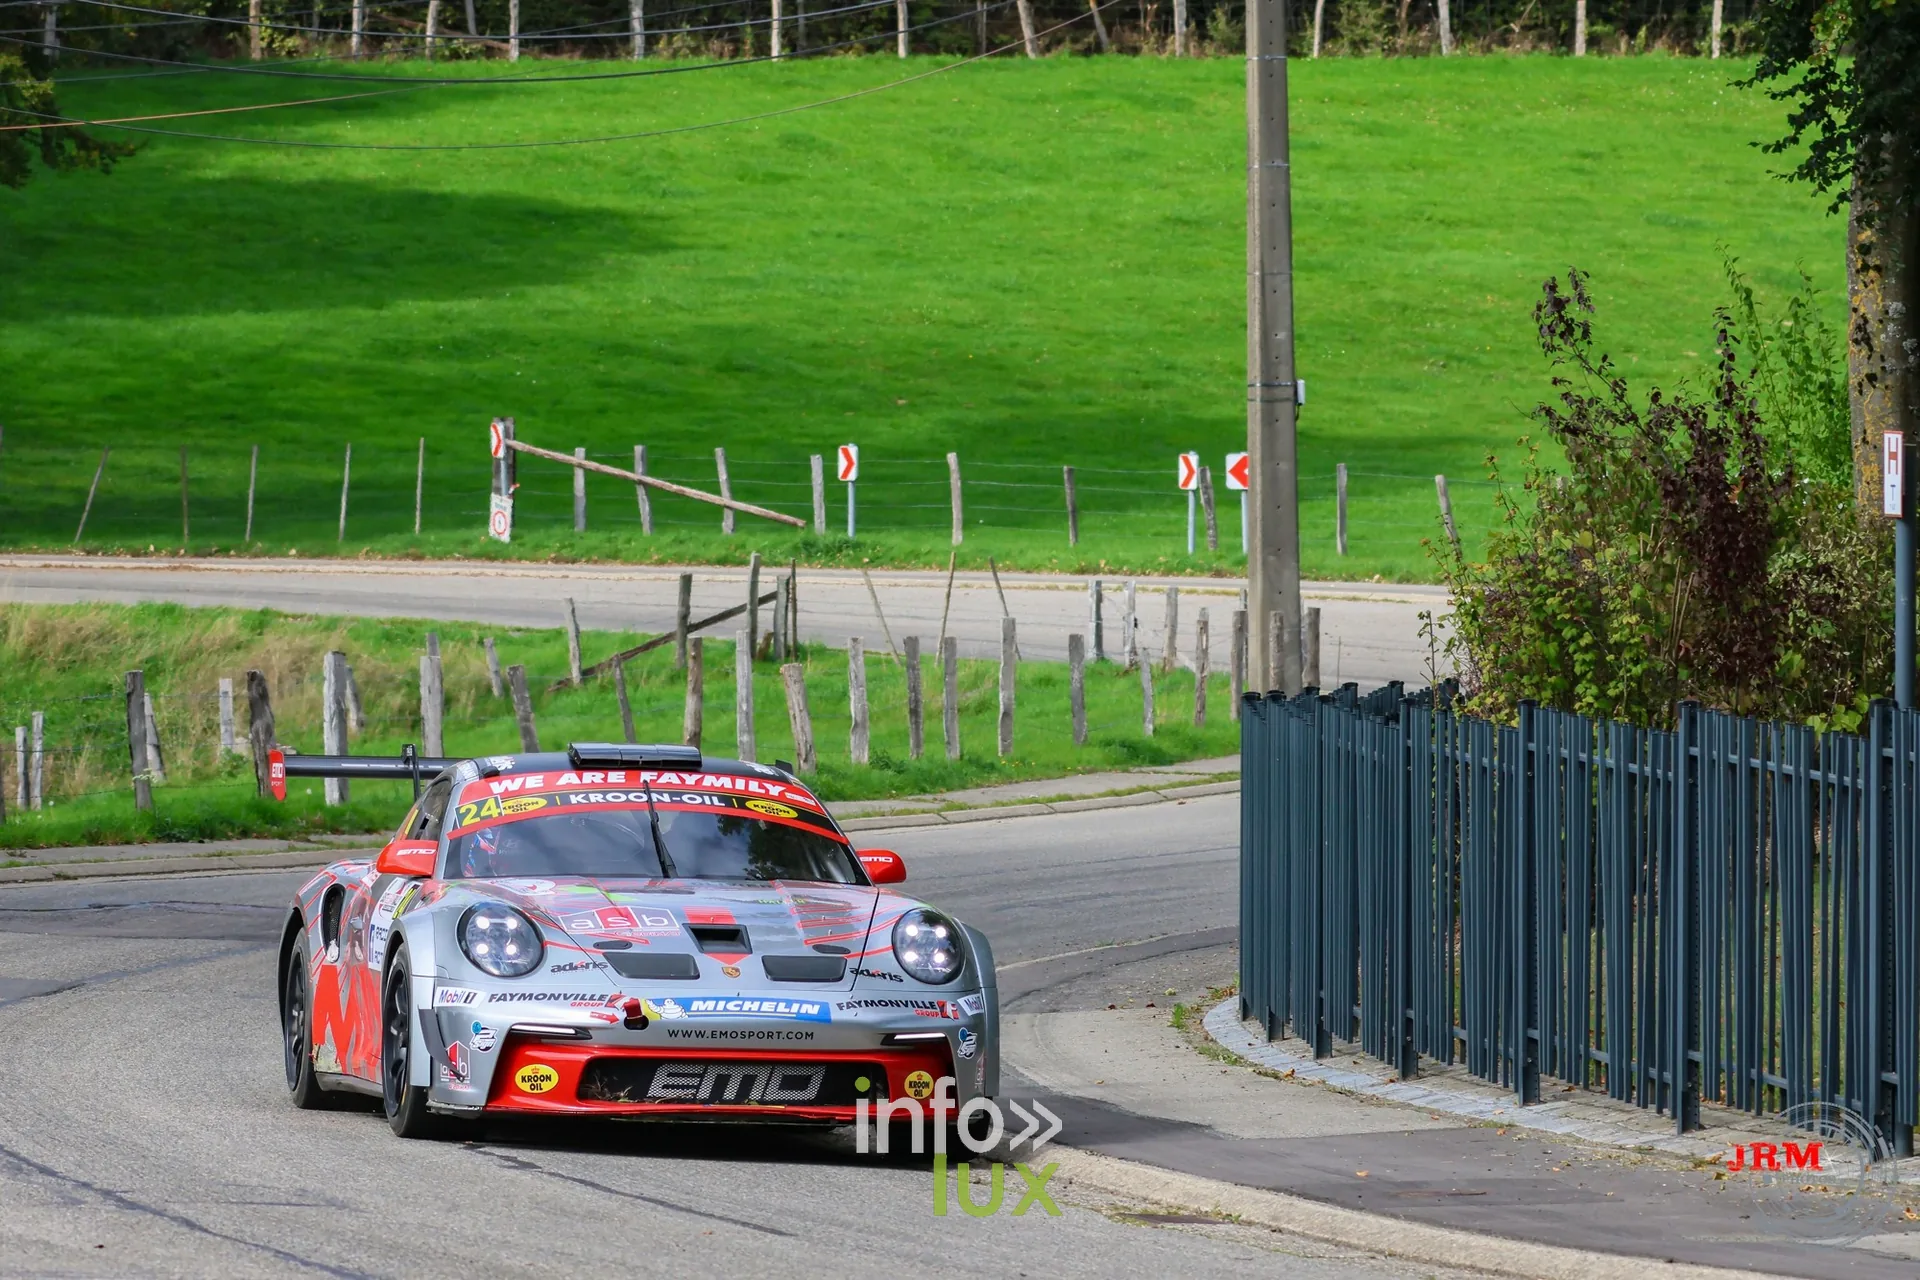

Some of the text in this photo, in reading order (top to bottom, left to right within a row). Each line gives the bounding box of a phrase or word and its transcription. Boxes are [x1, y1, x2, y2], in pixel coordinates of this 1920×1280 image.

[489, 771, 787, 797] WE ARE FAYMILY
[570, 792, 726, 807] KROON-OIL
[459, 796, 501, 827] 24
[753, 804, 790, 815] KROON
[396, 848, 437, 857] EMO
[571, 913, 669, 930] asb
[438, 989, 466, 1004] Mobil
[488, 992, 610, 1003] FAYMONVILLE
[690, 999, 821, 1015] MICHELIN
[836, 999, 938, 1010] FAYMONVILLE
[914, 1009, 939, 1018] GROUP
[667, 1029, 815, 1040] WWW.EMOSPORT.COM
[521, 1074, 552, 1083] KROON
[647, 1063, 826, 1101] EMO
[529, 1083, 544, 1091] OIL
[908, 1080, 931, 1089] KROON
[913, 1089, 924, 1098] OIL
